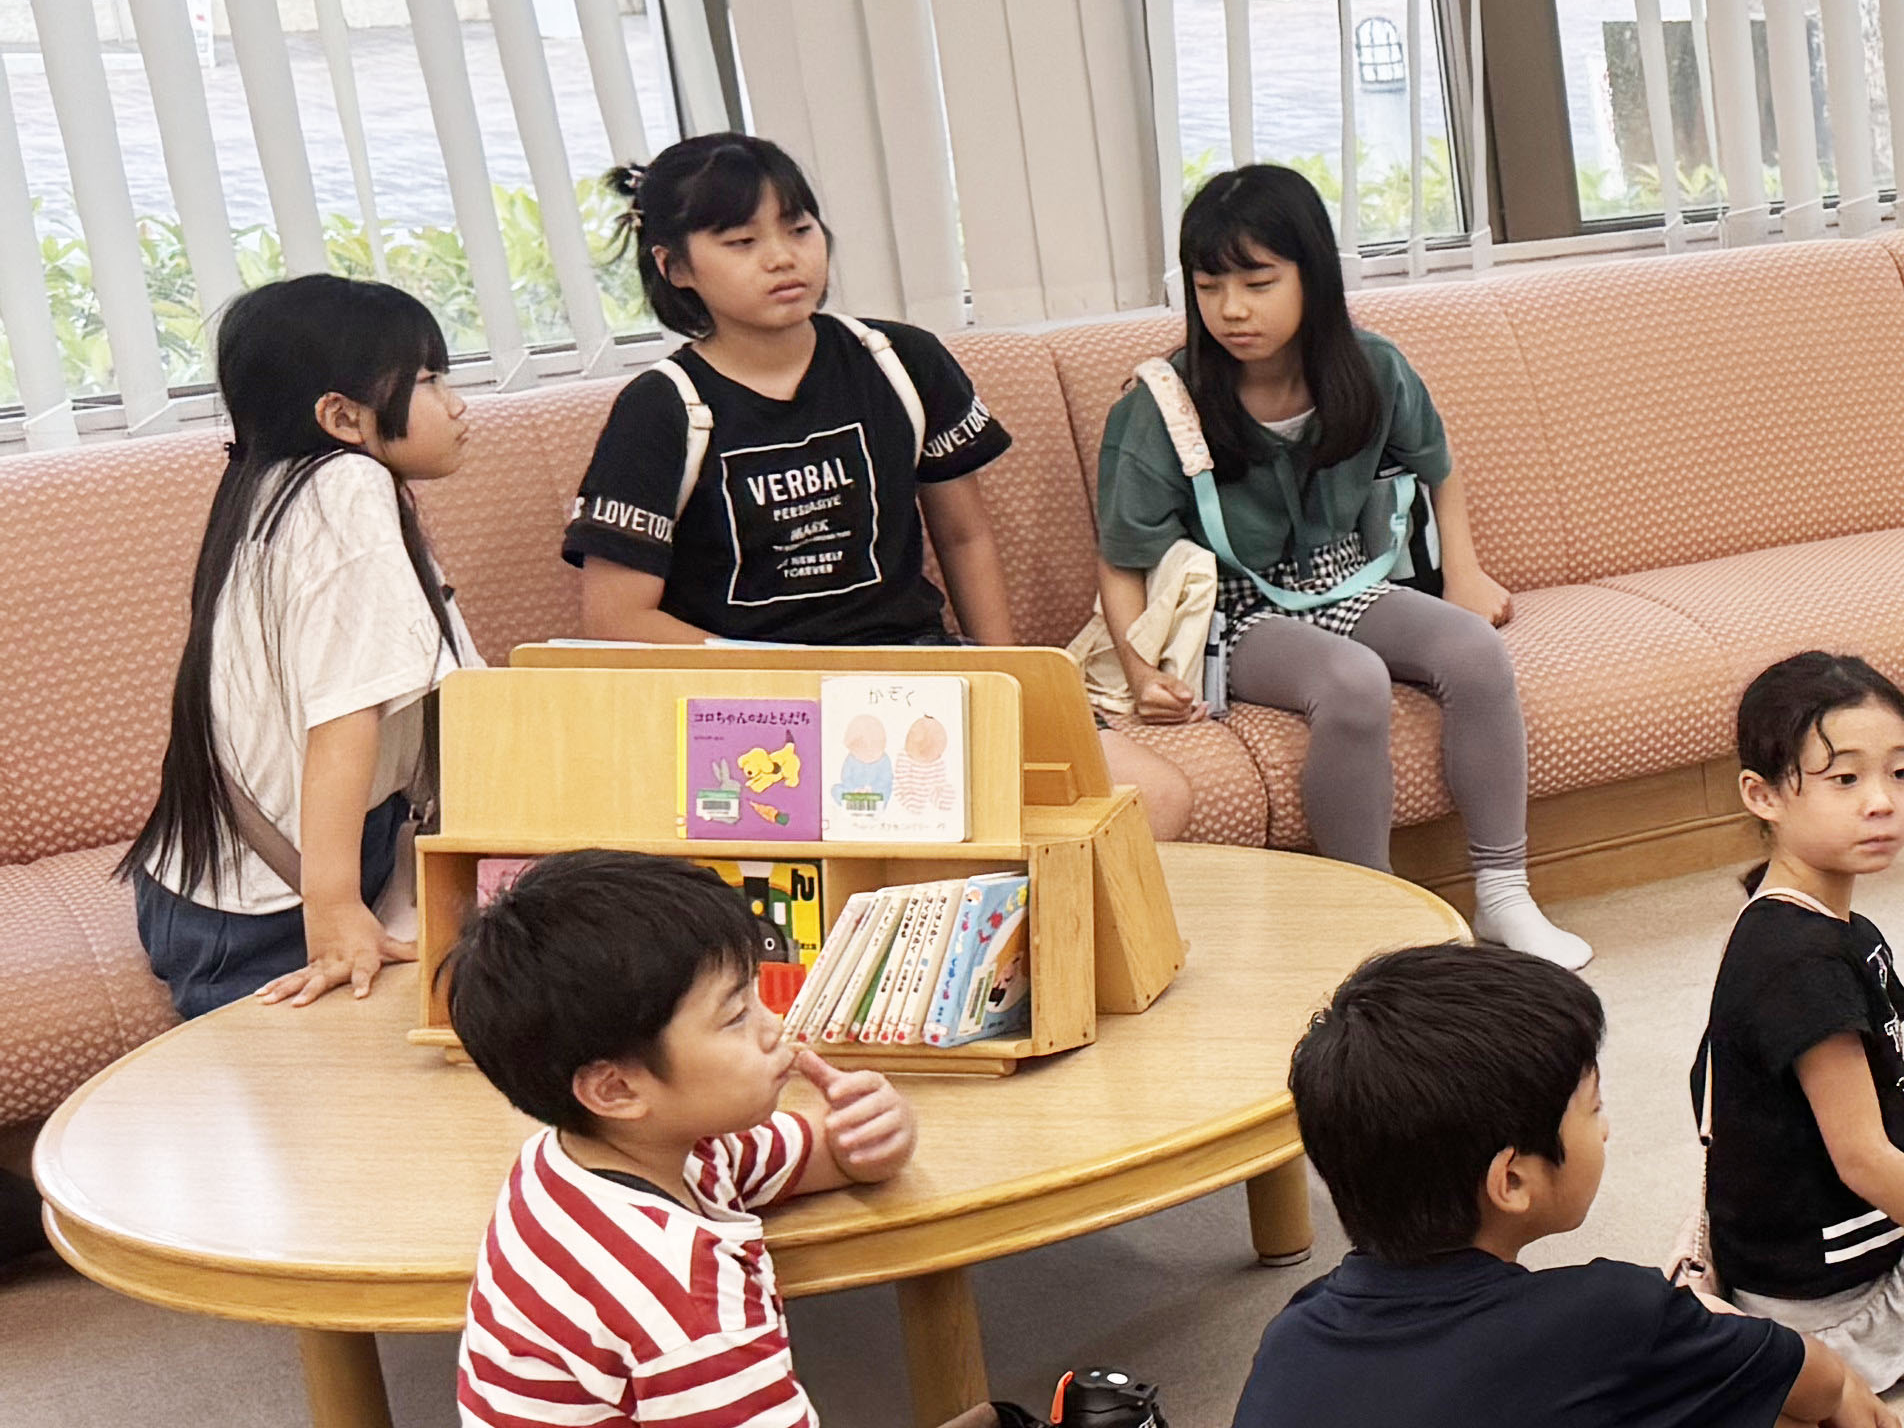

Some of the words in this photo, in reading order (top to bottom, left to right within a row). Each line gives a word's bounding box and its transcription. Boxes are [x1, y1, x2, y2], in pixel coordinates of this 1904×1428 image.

[746, 457, 855, 506] VERBAL
[868, 685, 918, 707] かぞく
[694, 711, 811, 726] コロちゃんのおともだち
